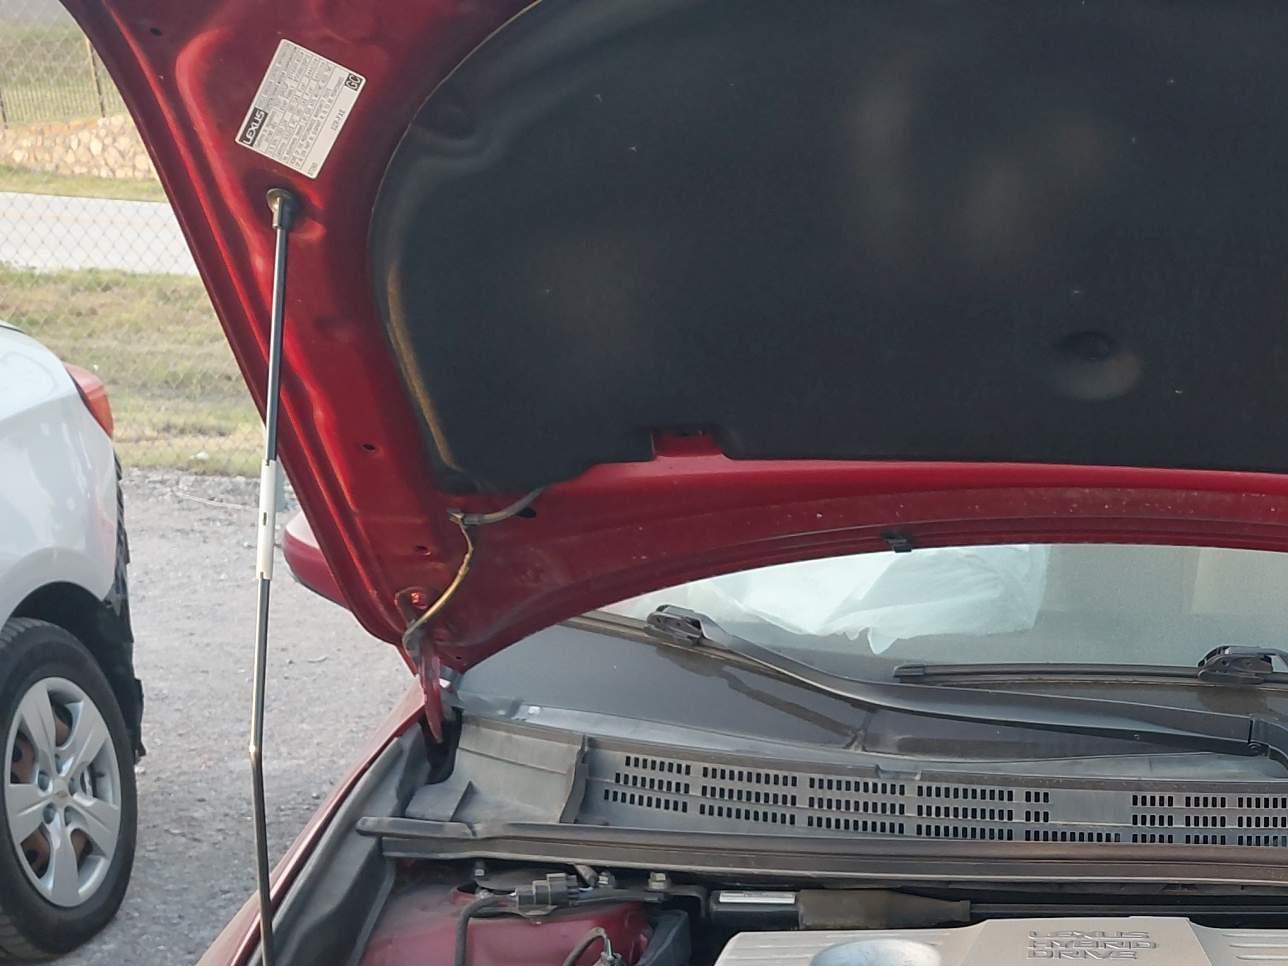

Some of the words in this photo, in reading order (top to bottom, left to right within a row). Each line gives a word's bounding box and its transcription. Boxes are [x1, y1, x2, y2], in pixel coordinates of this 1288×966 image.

[345, 73, 362, 90] GC
[242, 110, 265, 145] LEXUS
[1027, 930, 1151, 940] LEXUS
[1026, 940, 1157, 949] HYBRID
[1026, 950, 1138, 960] DRIVE
